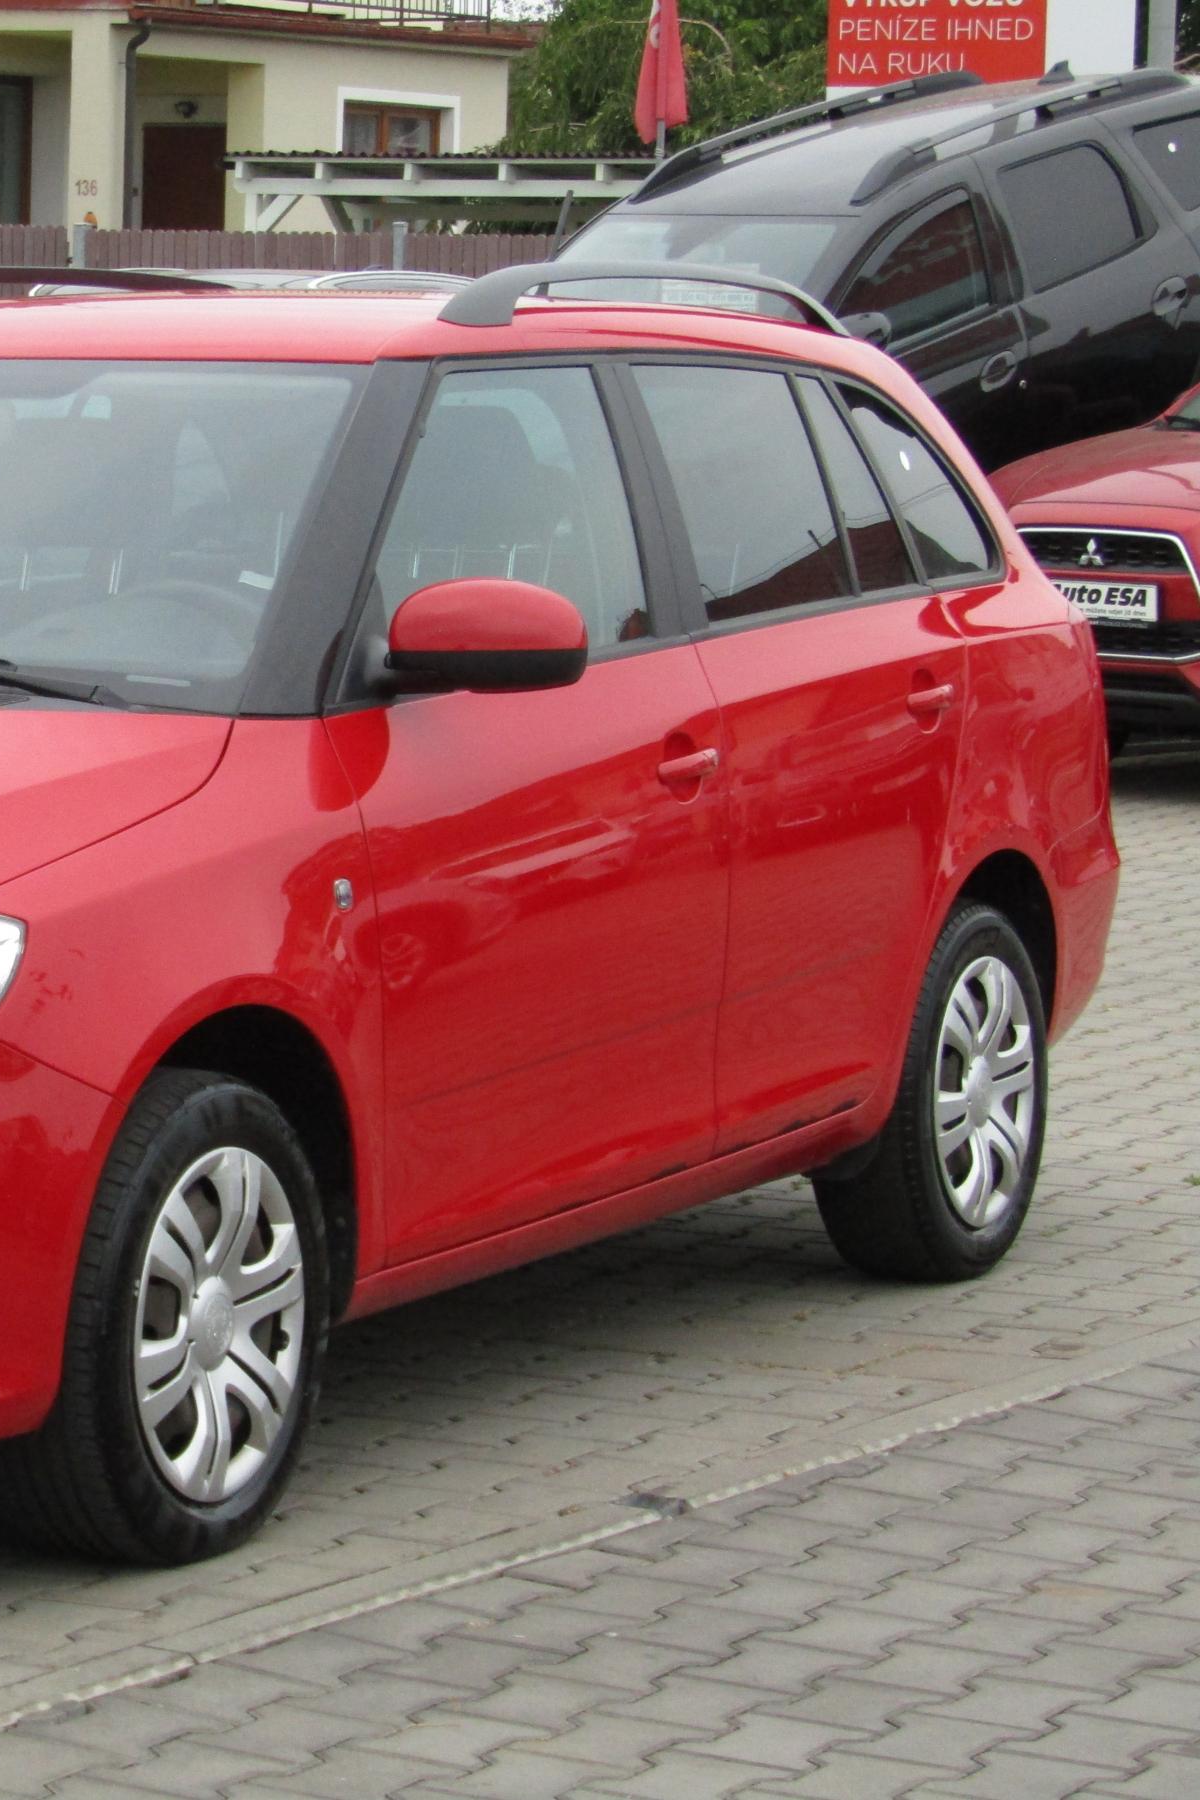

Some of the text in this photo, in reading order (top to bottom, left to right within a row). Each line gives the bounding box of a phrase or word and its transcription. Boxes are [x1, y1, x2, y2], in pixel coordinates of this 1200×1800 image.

[839, 14, 1034, 41] PENÍZE IHNED
[838, 53, 965, 75] NA RUKU
[75, 179, 97, 196] 136
[1104, 586, 1147, 607] ESA
